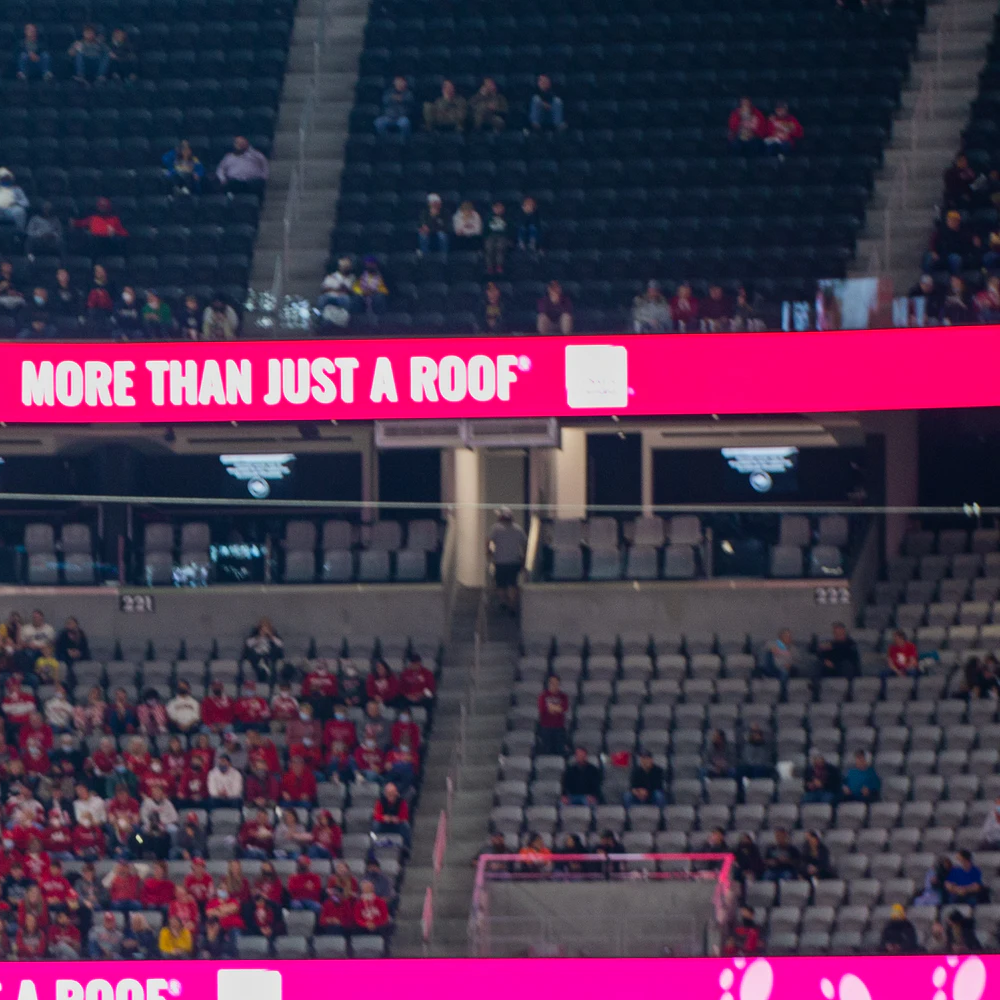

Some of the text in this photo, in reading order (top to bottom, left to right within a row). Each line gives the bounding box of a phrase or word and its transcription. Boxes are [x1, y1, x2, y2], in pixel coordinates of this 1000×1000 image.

[22, 361, 135, 406] MORE
[146, 359, 251, 405] THAN
[264, 358, 359, 405] JUST
[370, 357, 398, 402] A
[122, 594, 152, 611] 221
[815, 587, 850, 604] 222
